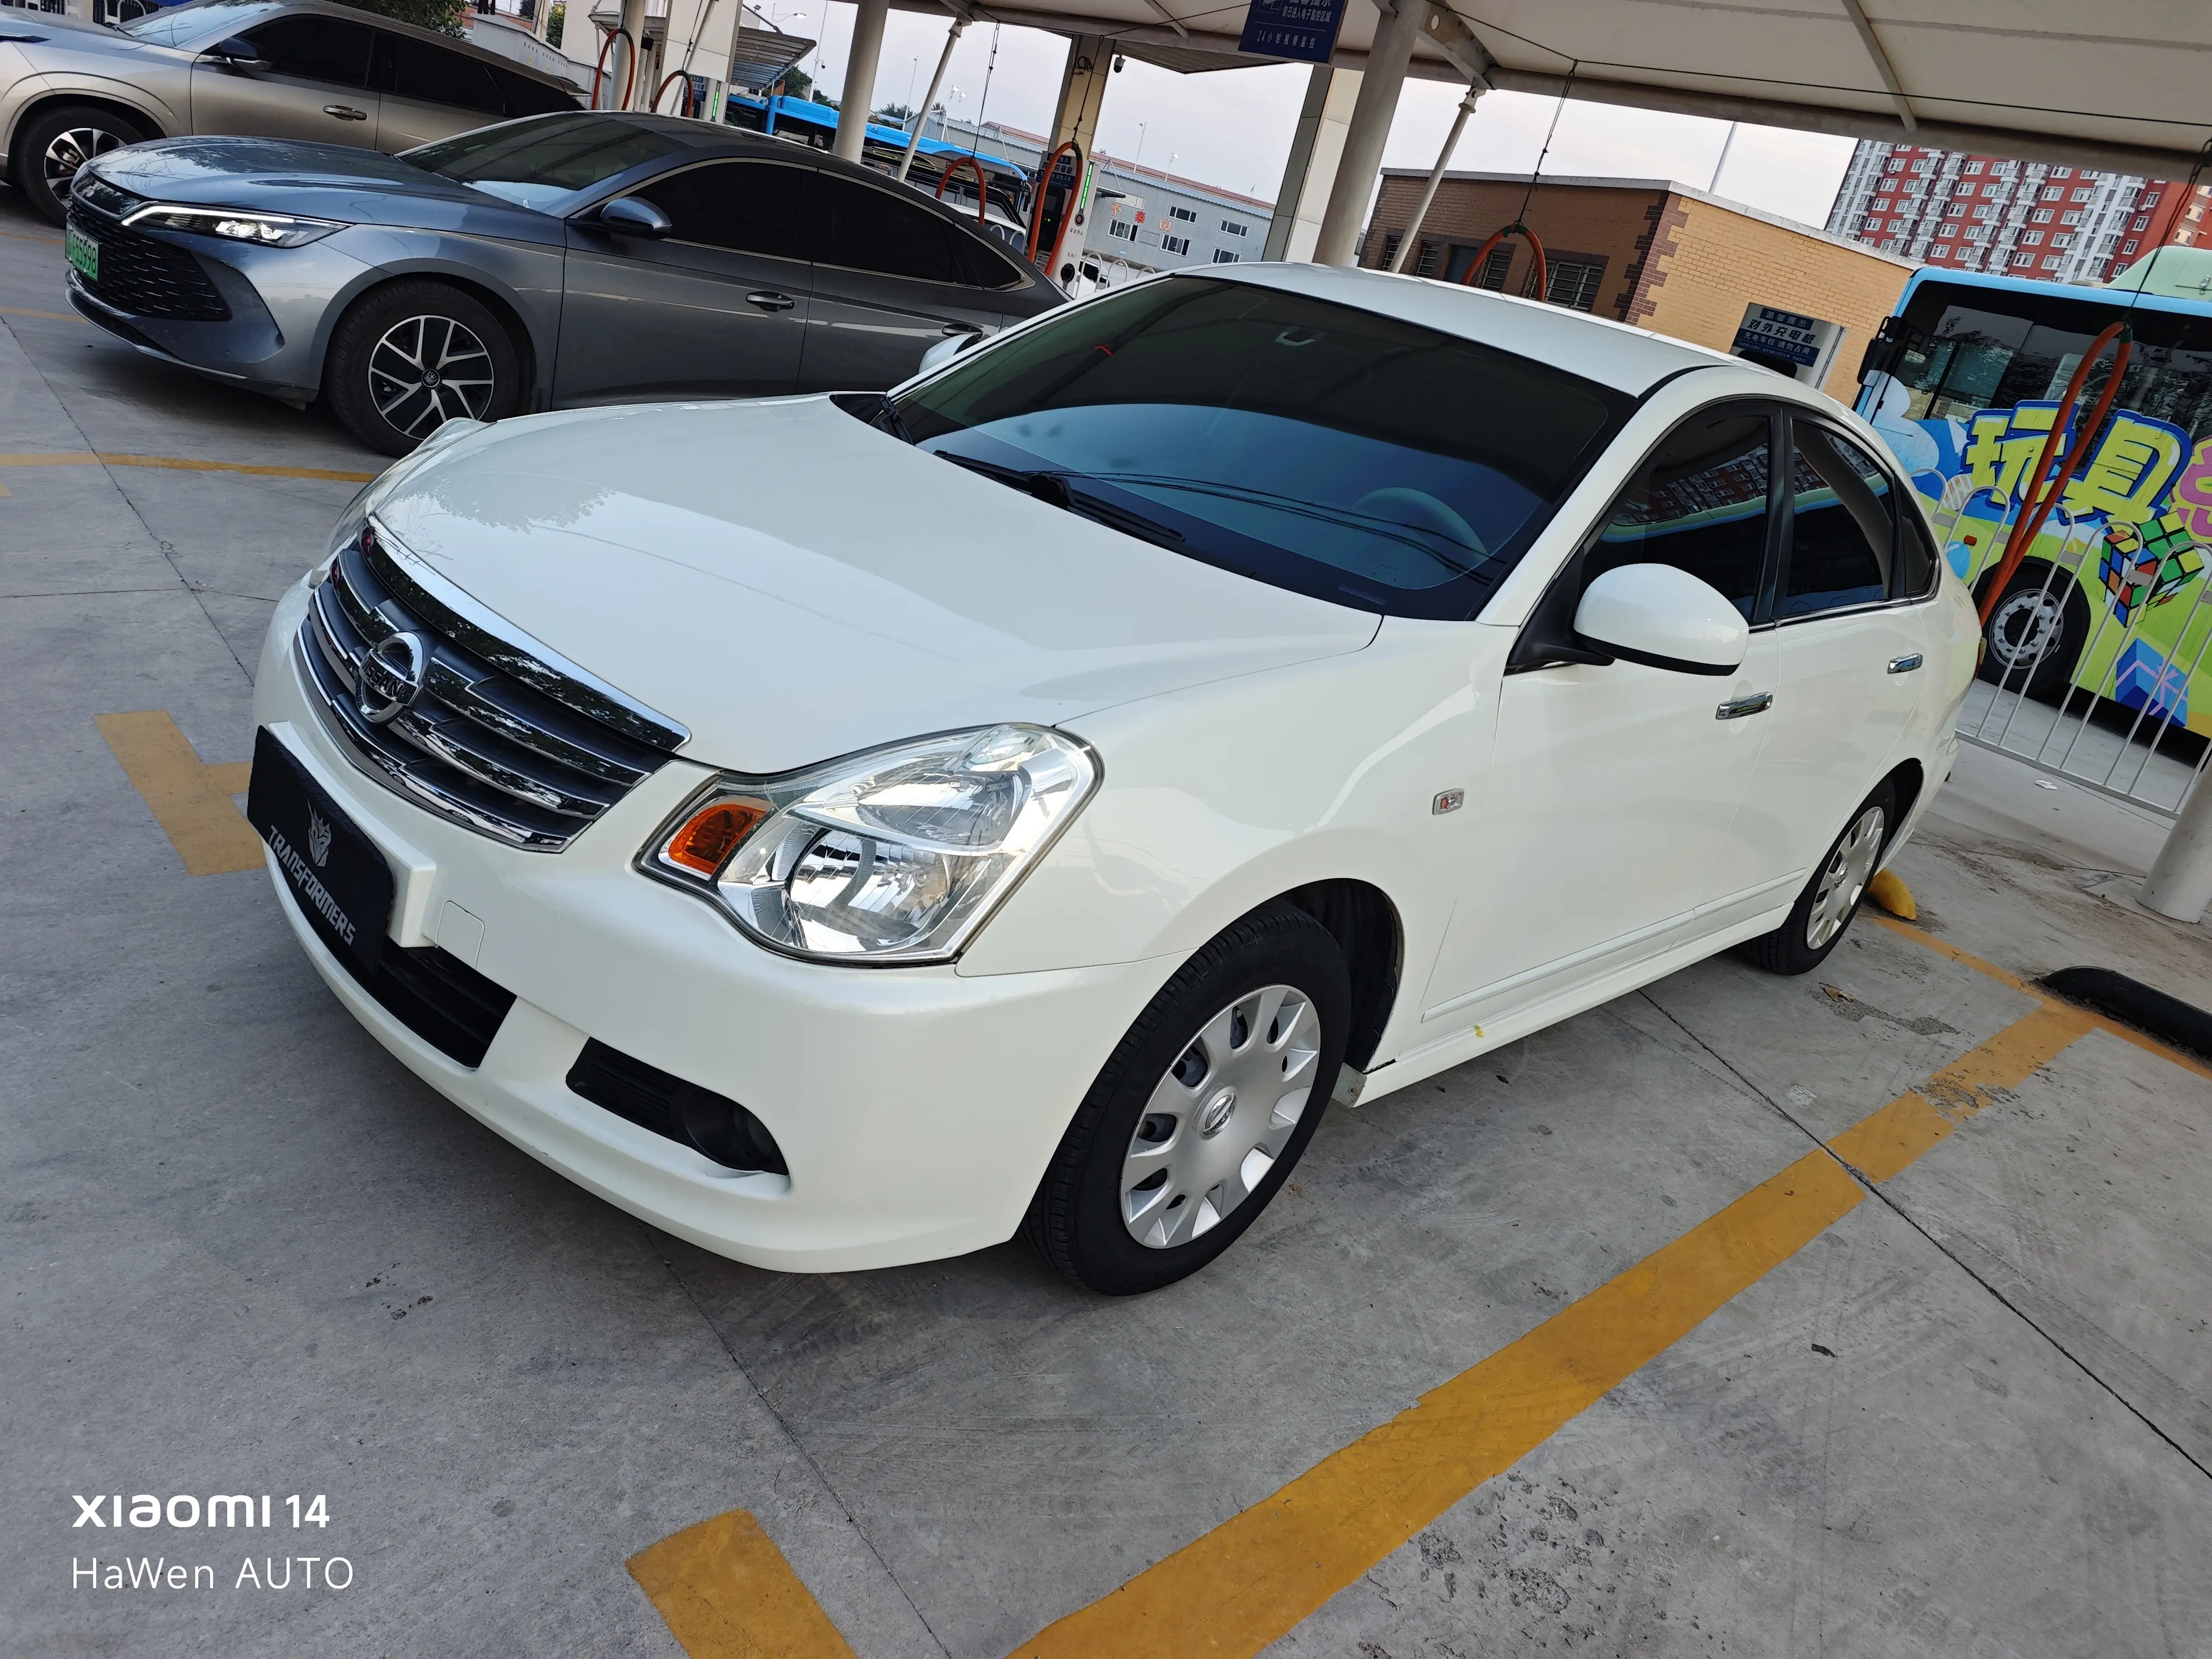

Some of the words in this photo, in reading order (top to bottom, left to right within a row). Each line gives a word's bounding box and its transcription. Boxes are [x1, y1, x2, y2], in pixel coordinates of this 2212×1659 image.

[1257, 30, 1316, 49] 24小时视频监控
[1765, 311, 1807, 327] 温馨提示
[1743, 332, 1776, 346] 充电车位
[1777, 340, 1810, 355] 请勿占用
[268, 824, 356, 946] TRANSFORMERS
